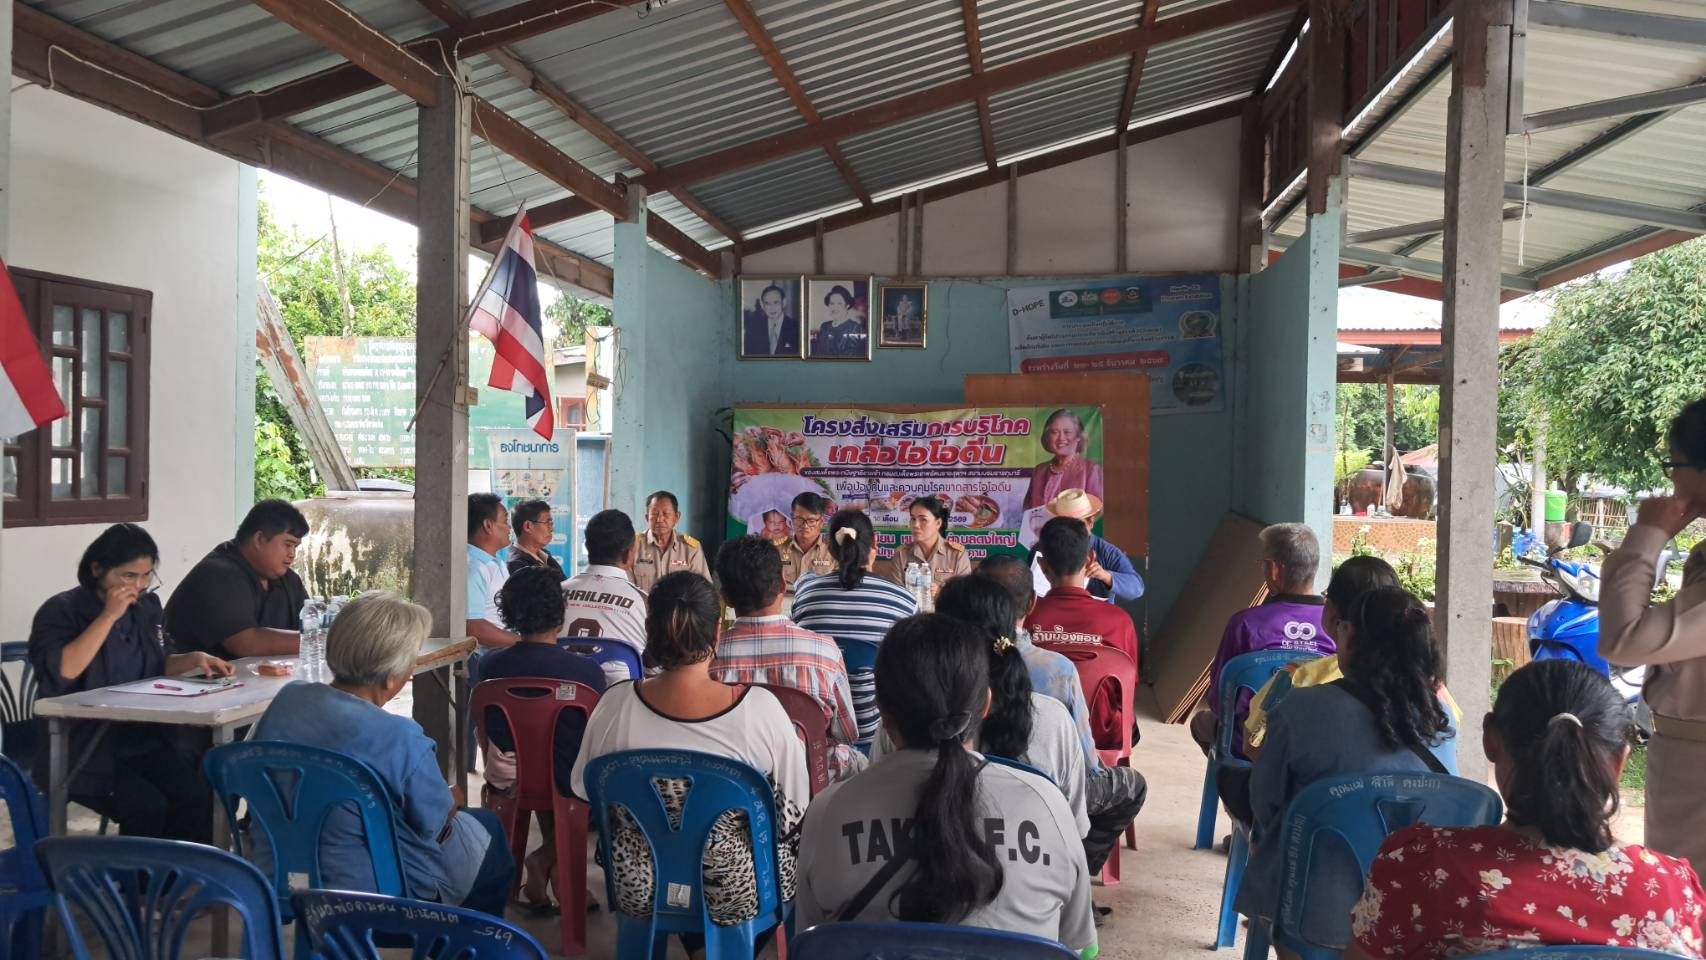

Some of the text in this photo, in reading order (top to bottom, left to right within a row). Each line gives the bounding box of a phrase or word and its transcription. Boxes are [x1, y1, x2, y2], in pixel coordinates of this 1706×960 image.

[1012, 299, 1045, 316] D-HOPE
[500, 439, 560, 453] ธงโภชนาการ
[828, 437, 1006, 466] เกลือไอโอดีน
[983, 818, 1050, 866] F.C.
